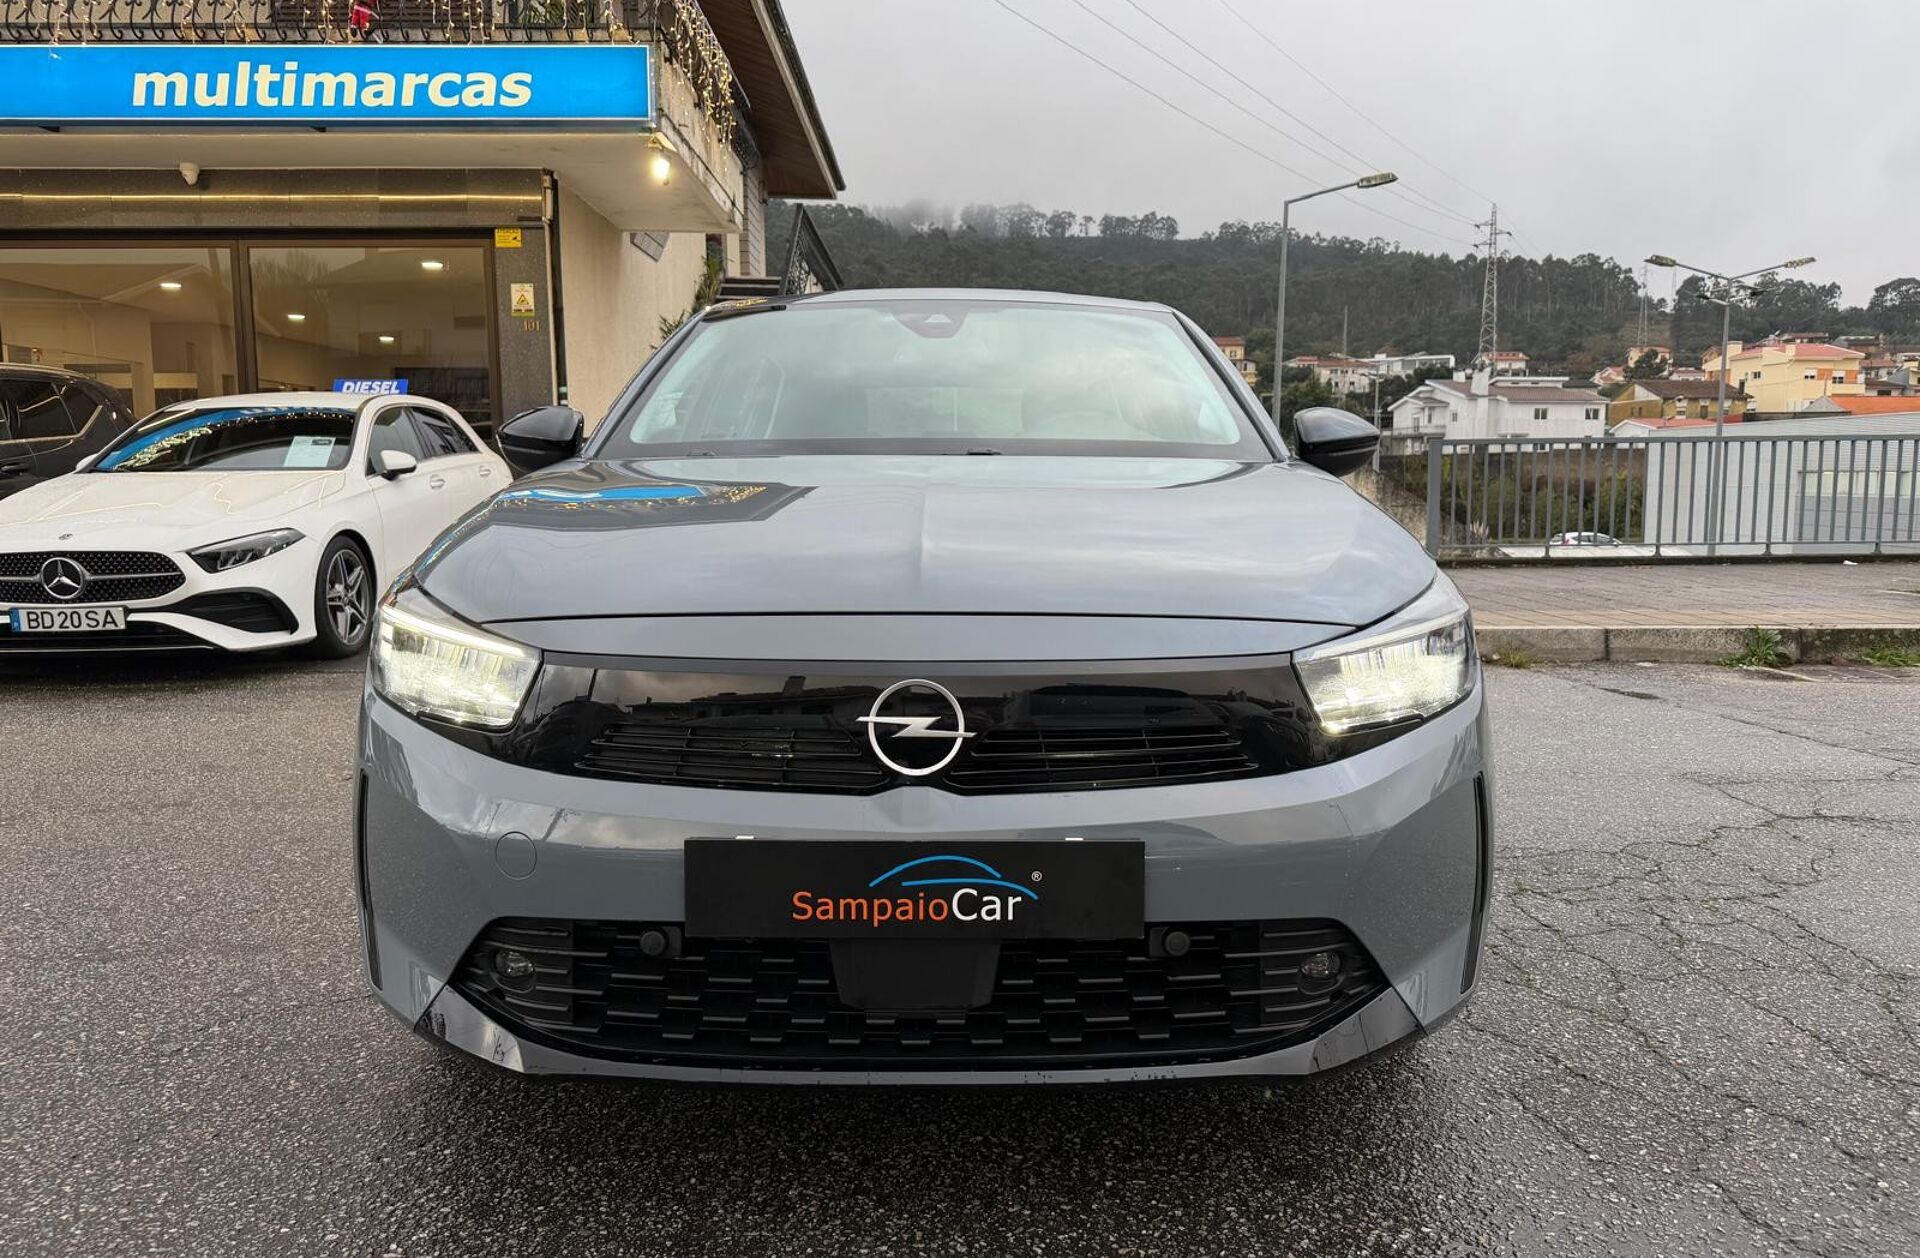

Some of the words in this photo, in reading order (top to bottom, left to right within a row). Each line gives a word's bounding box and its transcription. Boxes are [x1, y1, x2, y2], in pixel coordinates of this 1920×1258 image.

[132, 61, 533, 107] multimarcas
[342, 380, 401, 395] DIESEL
[792, 887, 1022, 928] SampaioCar
